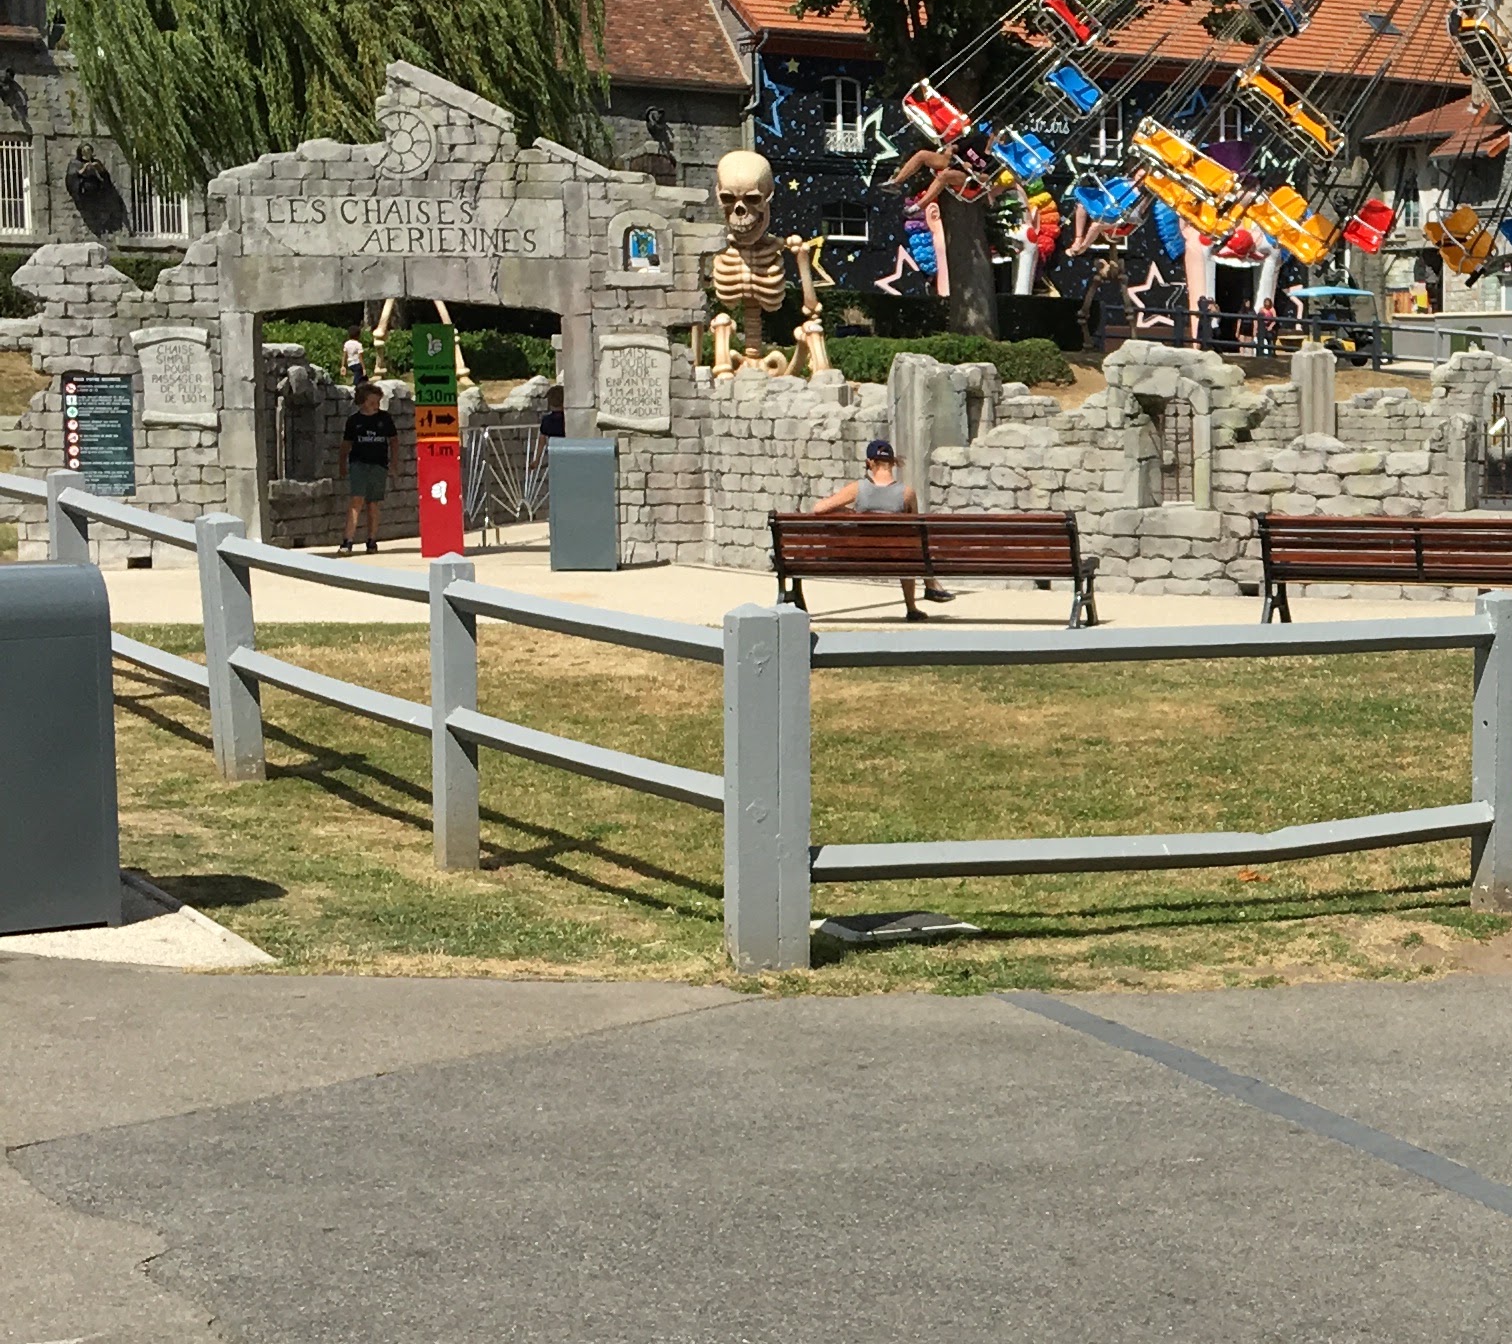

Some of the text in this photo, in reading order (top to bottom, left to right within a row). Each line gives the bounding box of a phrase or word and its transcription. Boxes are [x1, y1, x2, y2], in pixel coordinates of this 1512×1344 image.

[266, 198, 474, 225] LES CHAISES
[359, 227, 537, 253] AERIENNES
[157, 344, 194, 356] CHAISE
[611, 358, 658, 368] DOUBLE
[164, 365, 191, 374] POUR
[621, 367, 650, 378] POUR
[151, 374, 202, 385] PASSAGER
[177, 384, 202, 394] PLUS
